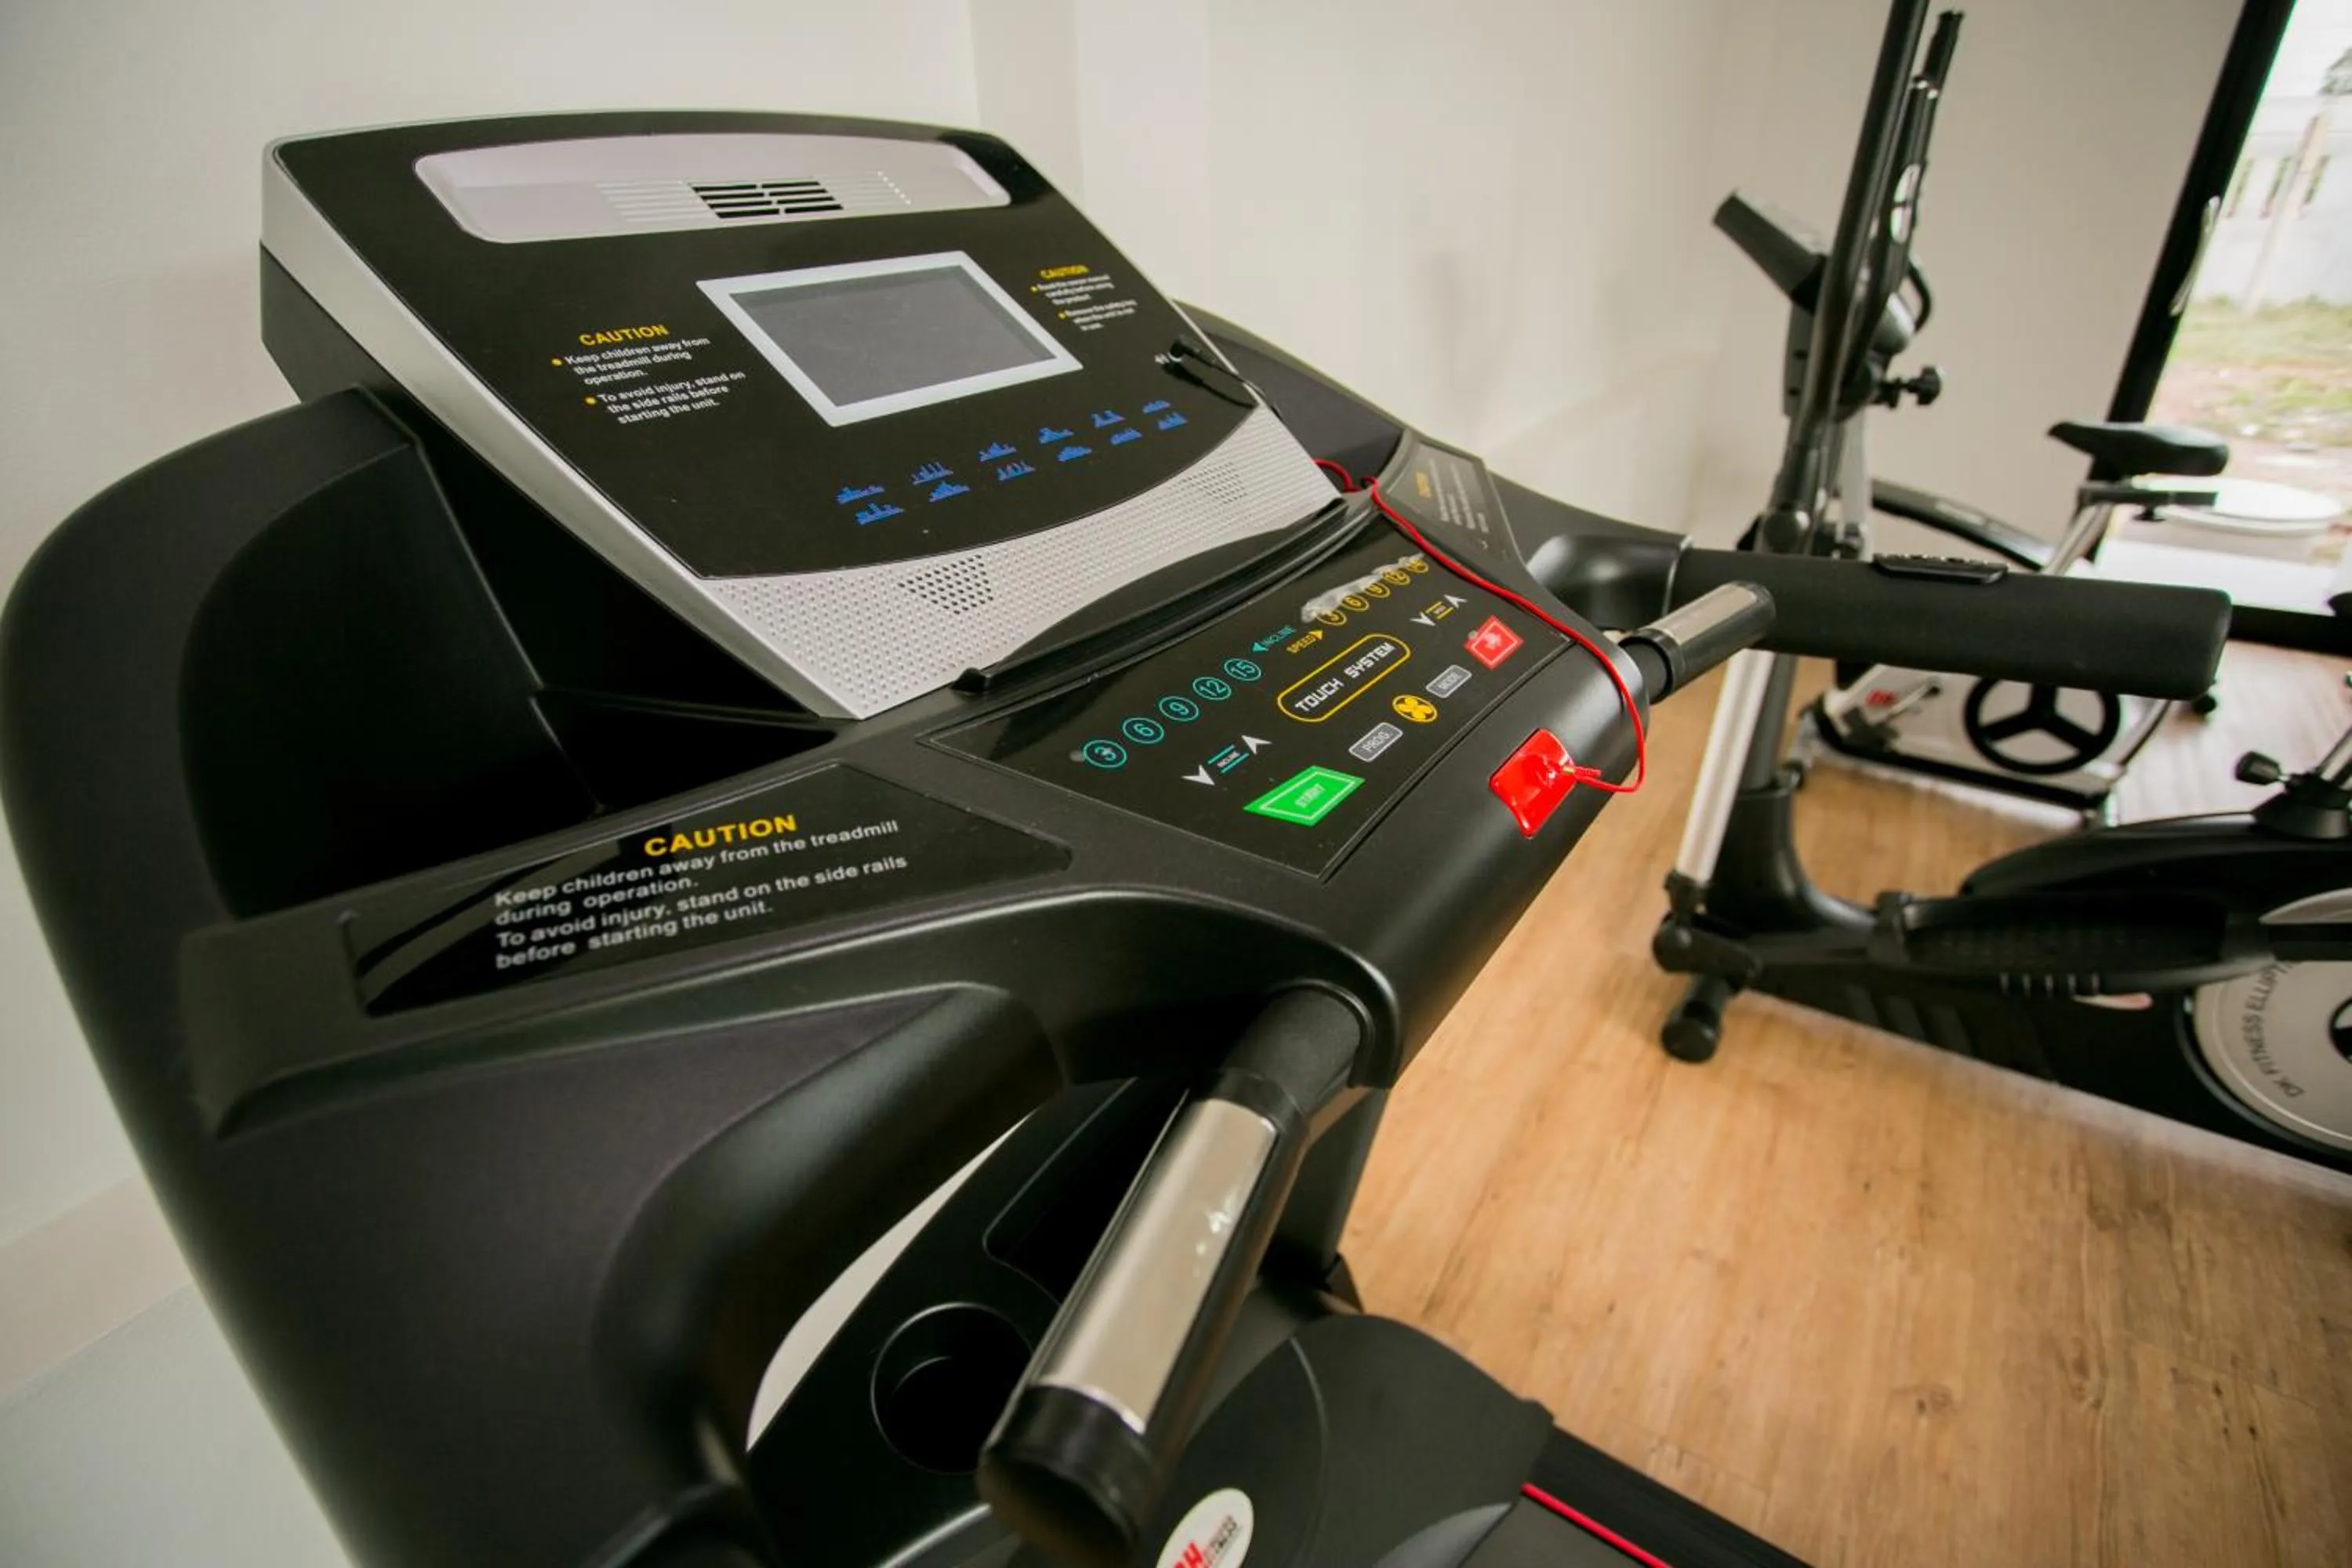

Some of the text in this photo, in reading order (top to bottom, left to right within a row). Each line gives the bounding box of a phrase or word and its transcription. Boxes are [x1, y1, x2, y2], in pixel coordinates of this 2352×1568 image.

[579, 324, 670, 346] CAUTION
[564, 338, 710, 365] Keep children away from
[574, 350, 692, 376] the treadmill during
[583, 368, 648, 386] operation.
[597, 394, 617, 403] To
[618, 387, 655, 401] avoid
[695, 372, 730, 387] stand
[729, 371, 746, 381] on
[607, 386, 730, 414] the side rails before
[618, 408, 671, 424] starting
[668, 403, 691, 415] the
[1287, 634, 1317, 654] SPEED
[1294, 642, 1396, 712] TOUCH SYSTEM
[1094, 661, 1256, 761] 3 6 9 12 15
[1361, 731, 1390, 752] PROG
[644, 814, 798, 857] CAUTION
[495, 819, 899, 907] Keep children away from the treadmill
[495, 877, 700, 926] during operation.
[495, 931, 526, 949] To
[530, 916, 596, 942] avoid
[677, 887, 739, 913] stand
[743, 883, 772, 898] on
[775, 874, 811, 892] the
[814, 865, 859, 885] side
[862, 855, 909, 876] rails
[495, 901, 773, 969] before starting the unit.
[2242, 1014, 2279, 1075] FITNESS
[2274, 1076, 2305, 1098] DK
